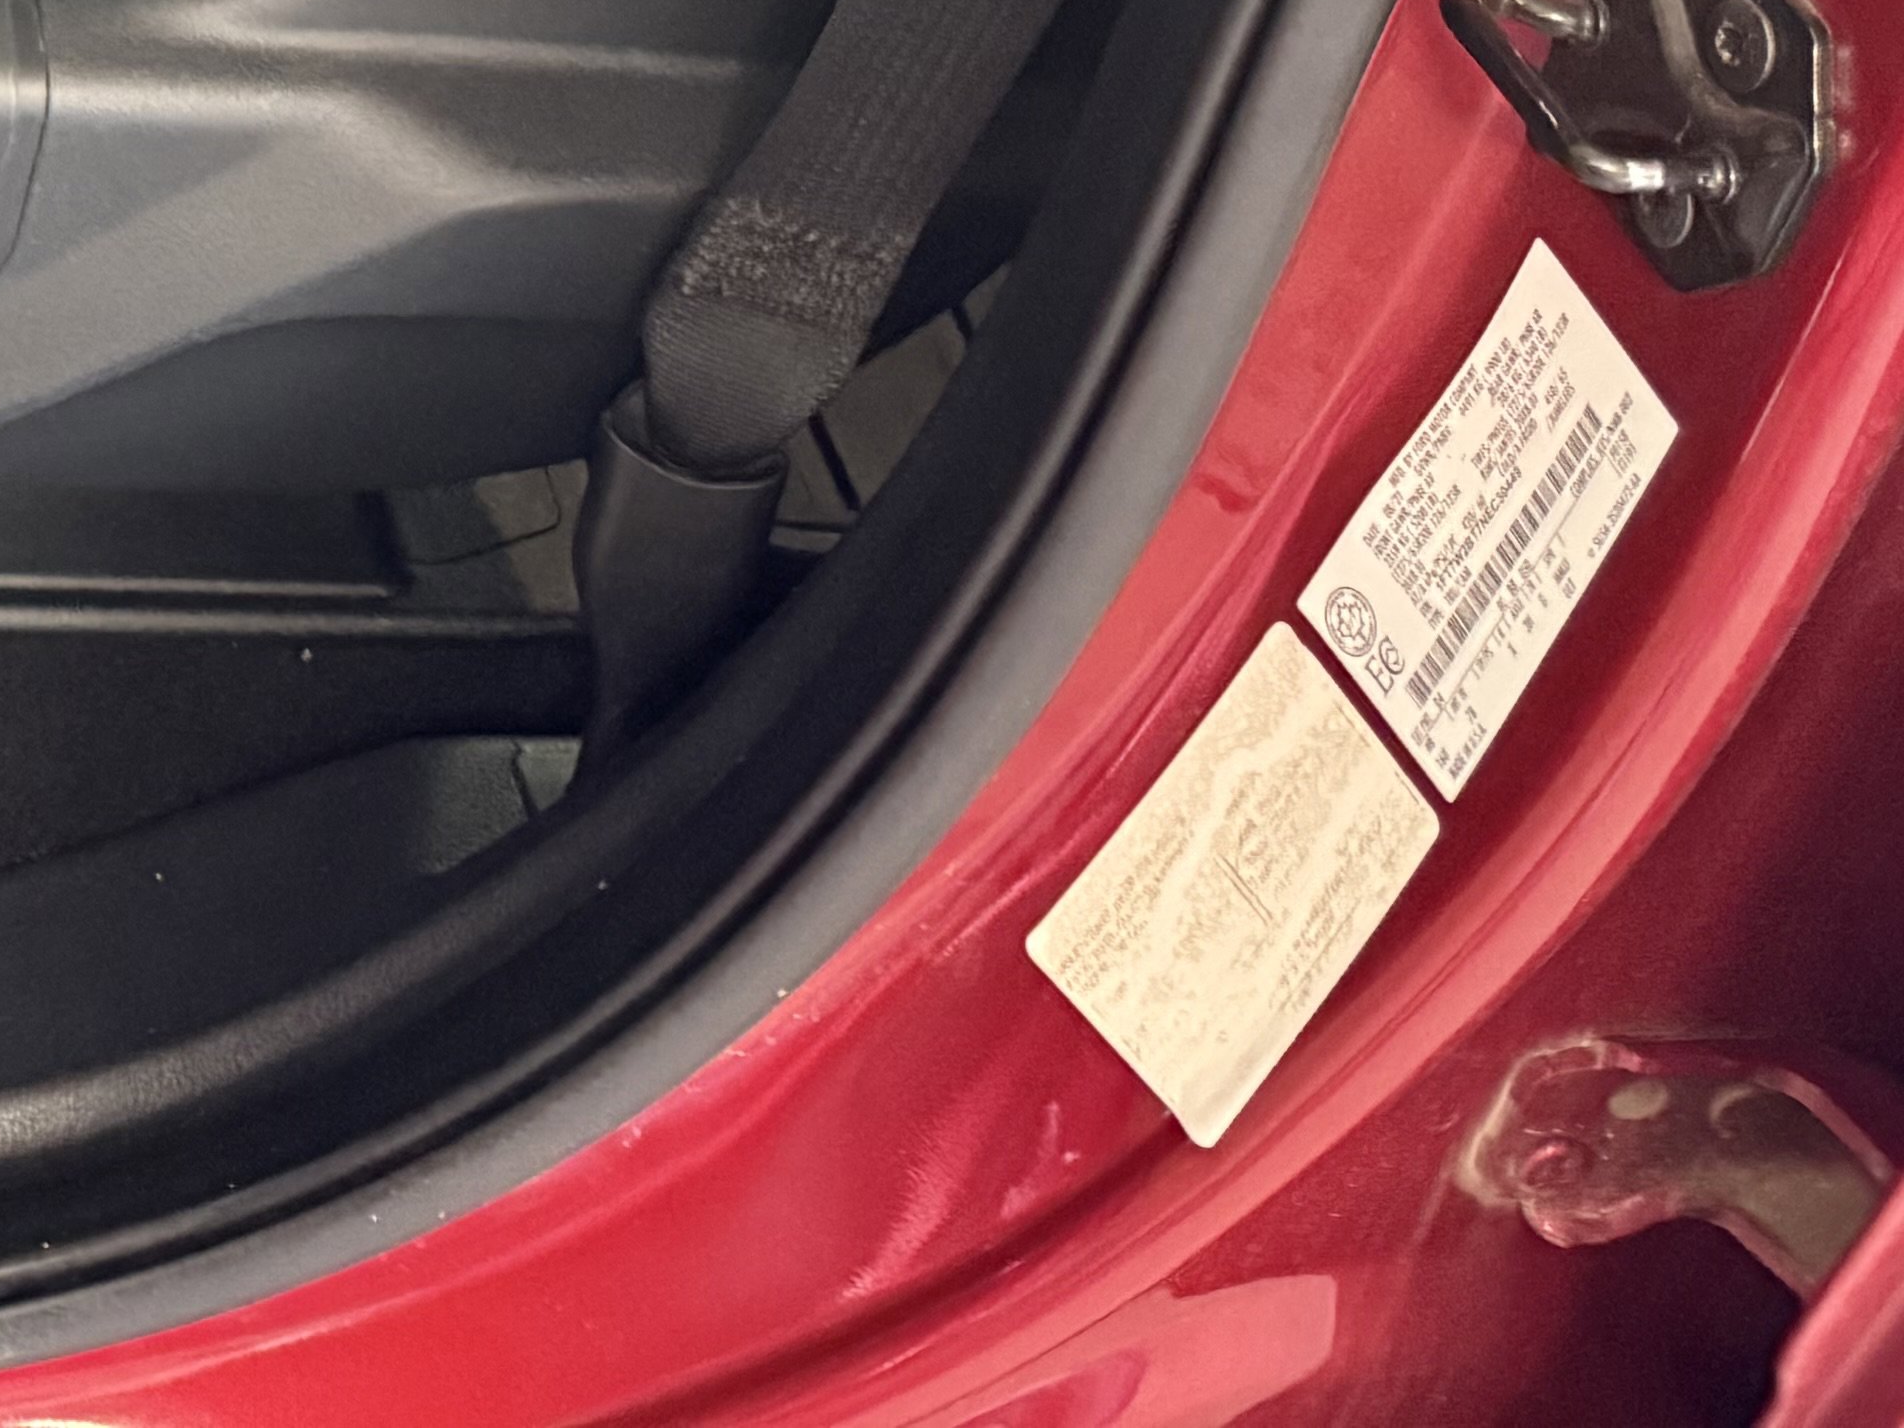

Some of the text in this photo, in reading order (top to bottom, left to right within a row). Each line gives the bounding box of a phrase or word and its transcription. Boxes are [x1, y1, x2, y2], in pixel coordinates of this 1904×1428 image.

[1410, 427, 1432, 458] FORD
[1427, 400, 1452, 436] MOTOR
[1447, 361, 1479, 407] COMPANY
